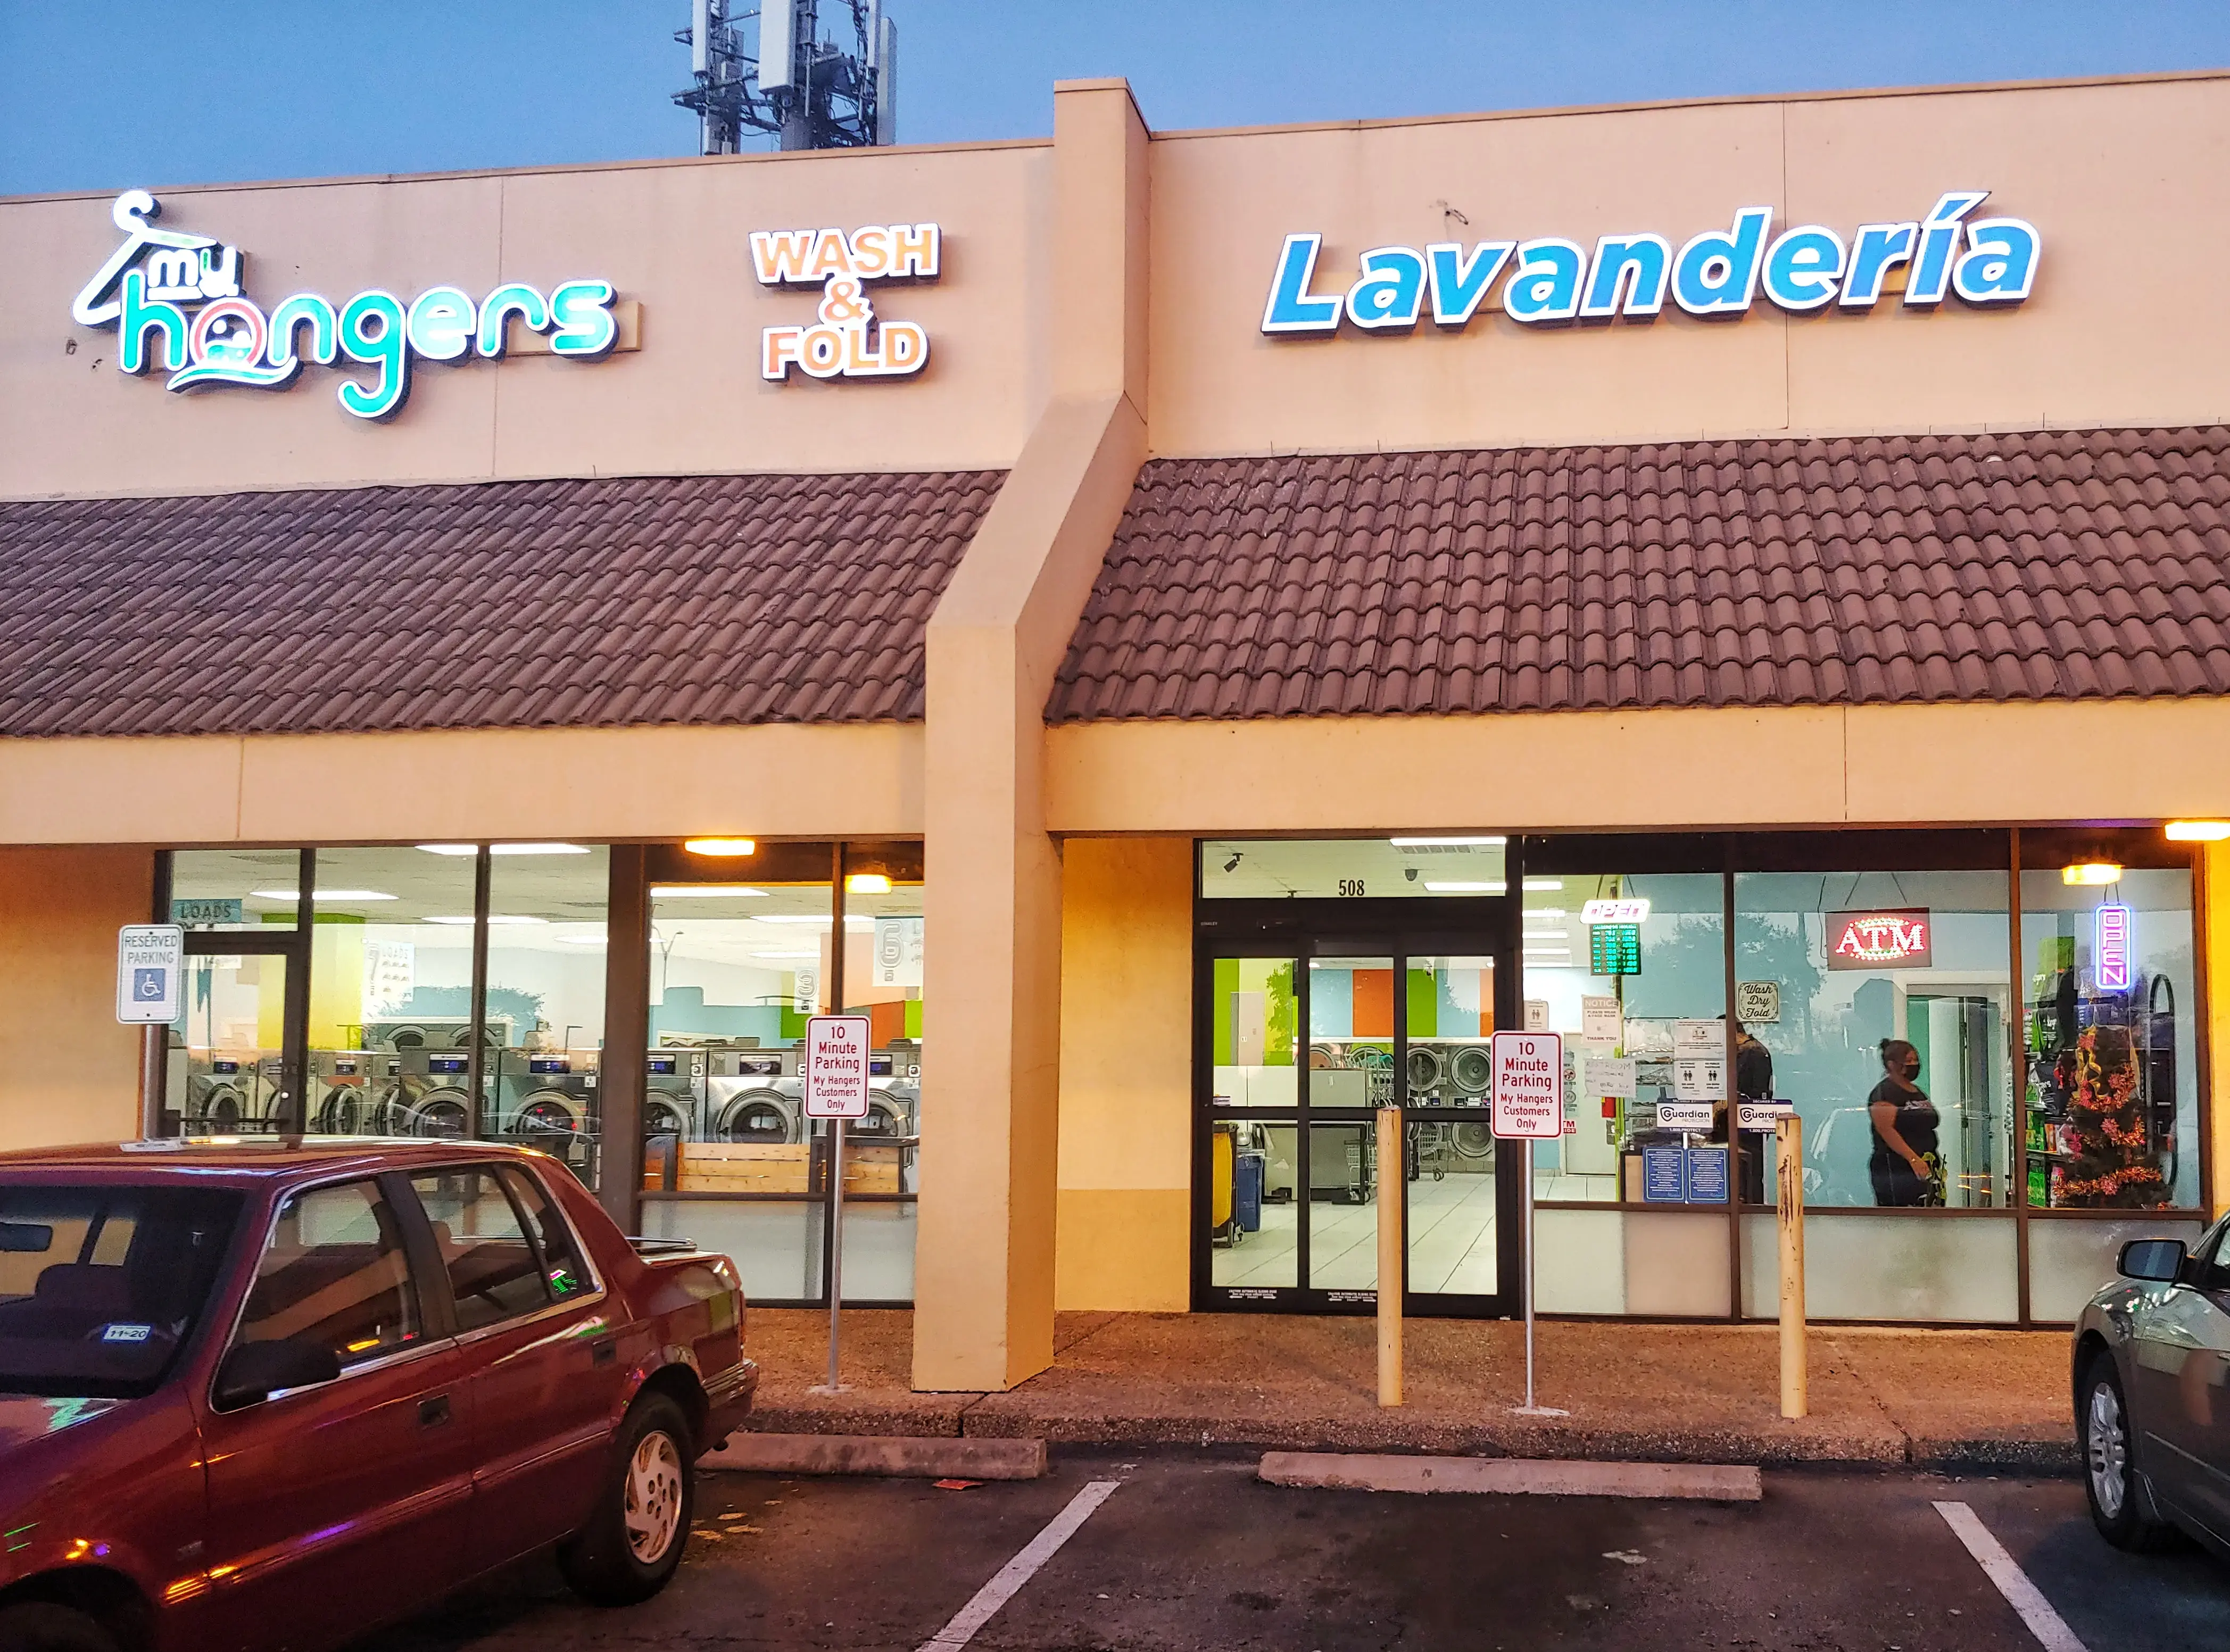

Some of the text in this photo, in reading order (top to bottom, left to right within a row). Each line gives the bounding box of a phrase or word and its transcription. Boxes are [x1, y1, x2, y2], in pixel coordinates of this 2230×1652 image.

[749, 223, 939, 283] WASH
[1262, 191, 2042, 332] Lavandería
[818, 274, 874, 326] &
[120, 268, 614, 418] hangers
[762, 321, 927, 379] FOLD
[1338, 879, 1365, 896] 508
[125, 935, 178, 948] RESERVED
[1836, 924, 1925, 953] ATM
[2102, 911, 2125, 985] OPEN
[127, 951, 175, 964] PARKING
[1744, 984, 1773, 994] Wash
[1747, 995, 1770, 1007] Dry
[1746, 1008, 1770, 1017] Fold
[831, 1026, 845, 1039] 10
[819, 1041, 857, 1054] Minute
[1519, 1042, 1535, 1055] 10
[815, 1056, 859, 1073] Parking
[1505, 1058, 1548, 1071] Minute
[814, 1075, 860, 1087] My Hangers
[1502, 1073, 1552, 1091] Parking
[816, 1088, 857, 1097] Customers
[827, 1099, 845, 1111] Only
[1501, 1093, 1553, 1106] My Hangers
[1504, 1106, 1550, 1116] Customers
[1663, 1110, 1710, 1118] Guardian
[1516, 1118, 1537, 1130] Only
